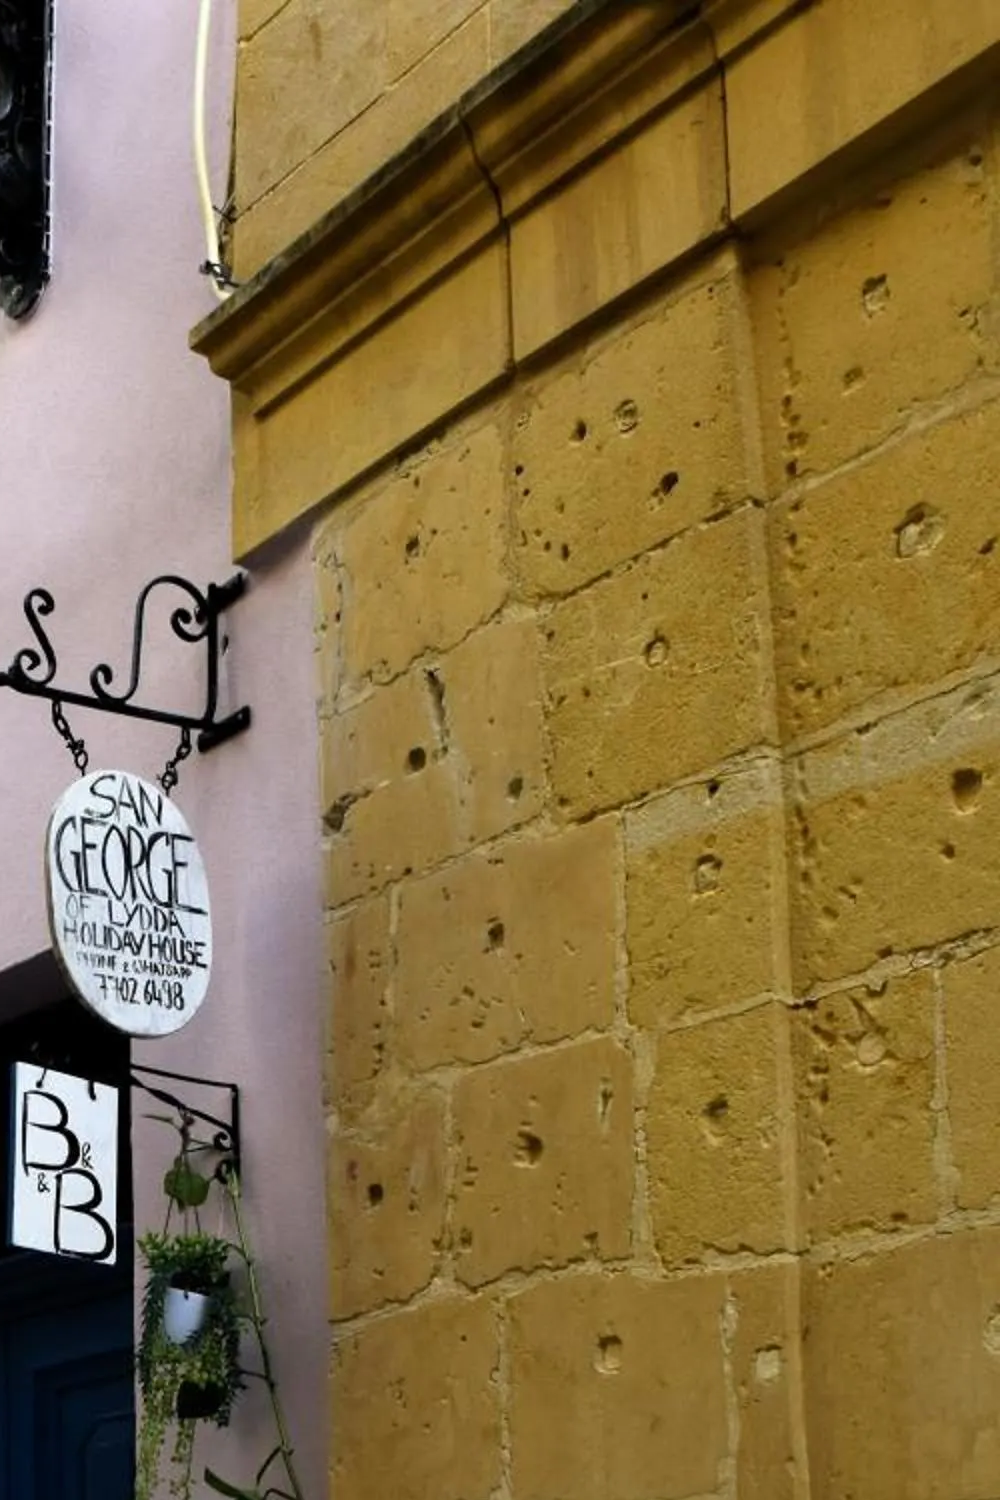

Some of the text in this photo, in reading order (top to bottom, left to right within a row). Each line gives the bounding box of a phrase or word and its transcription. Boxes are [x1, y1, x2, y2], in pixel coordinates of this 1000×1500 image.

[90, 774, 163, 827] SAN
[55, 816, 208, 915] GEORGE
[65, 894, 186, 938] OF LYDDA
[63, 919, 207, 969] HOLIDAY HOUSE
[143, 978, 185, 1011] 6498
